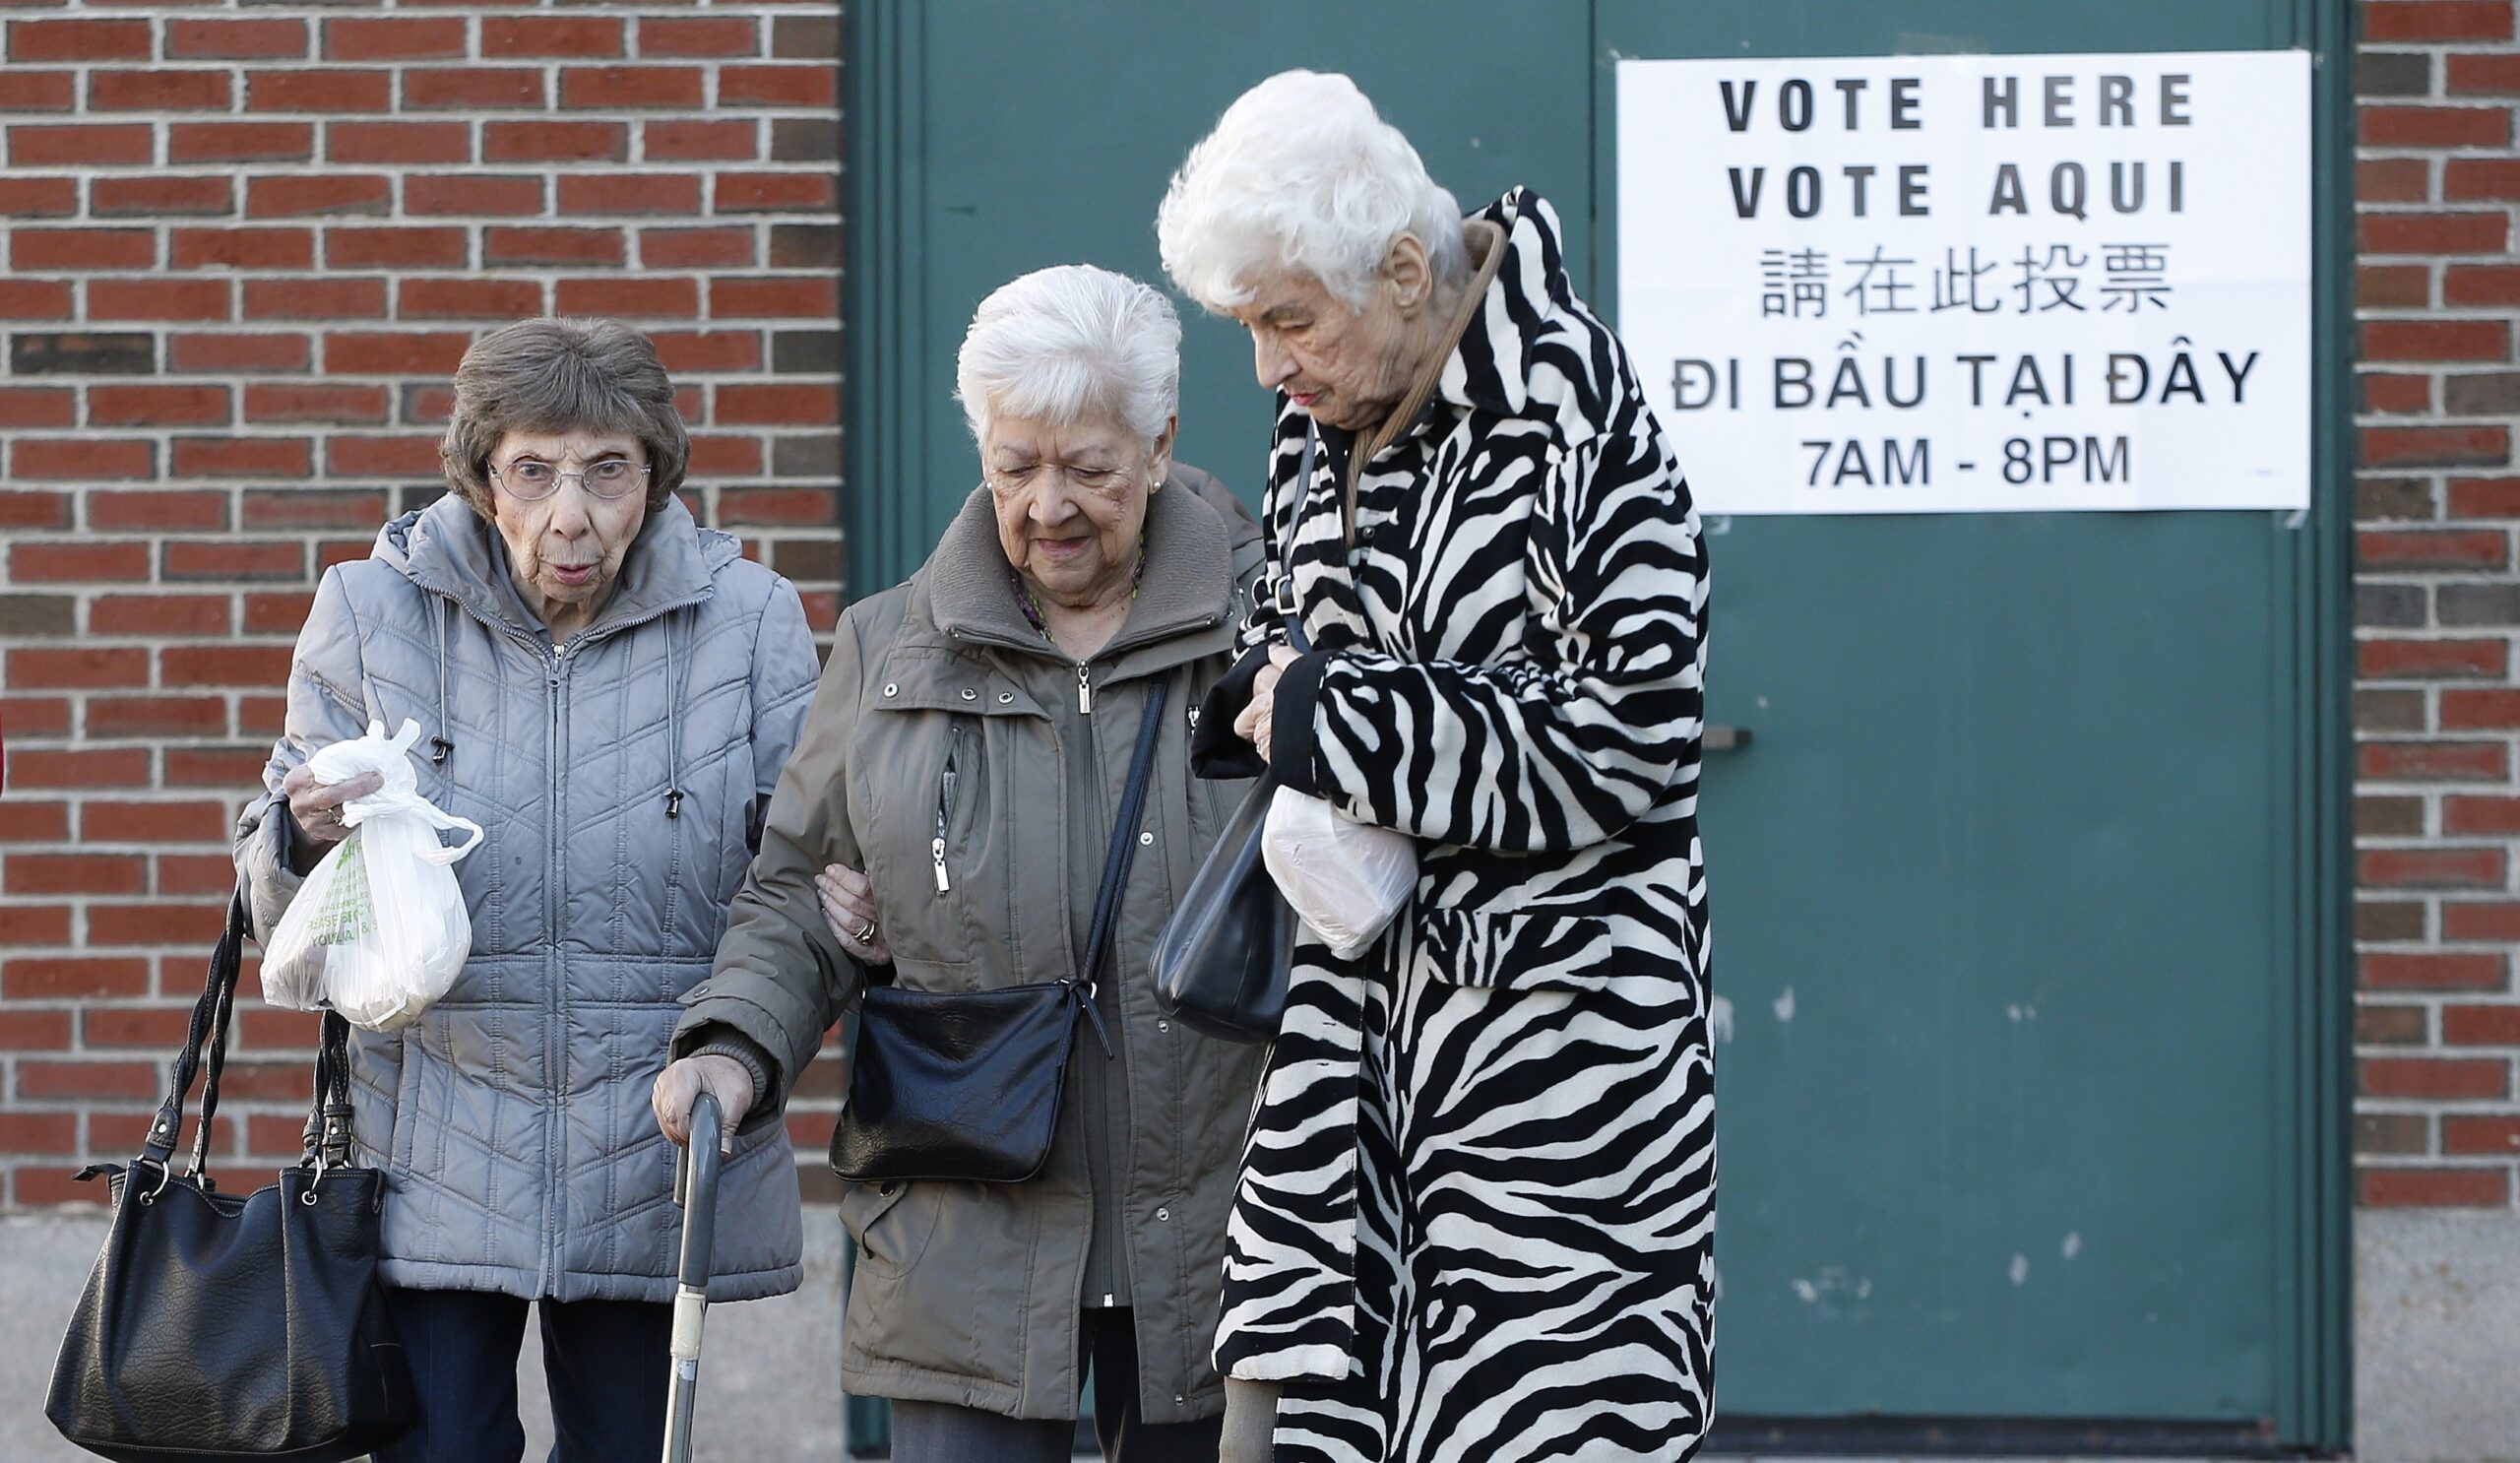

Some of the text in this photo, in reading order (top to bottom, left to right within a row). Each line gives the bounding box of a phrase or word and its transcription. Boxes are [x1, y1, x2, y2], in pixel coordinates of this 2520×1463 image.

[1719, 74, 2192, 132] VOTE HERE
[1728, 160, 2183, 222] VOTE AQUI
[1760, 244, 2174, 318] 請在此投票
[1671, 331, 2260, 418] ĐI BẦU TẠI ĐÂY
[1800, 437, 1929, 486] 7AM
[2002, 435, 2130, 484] 8PM
